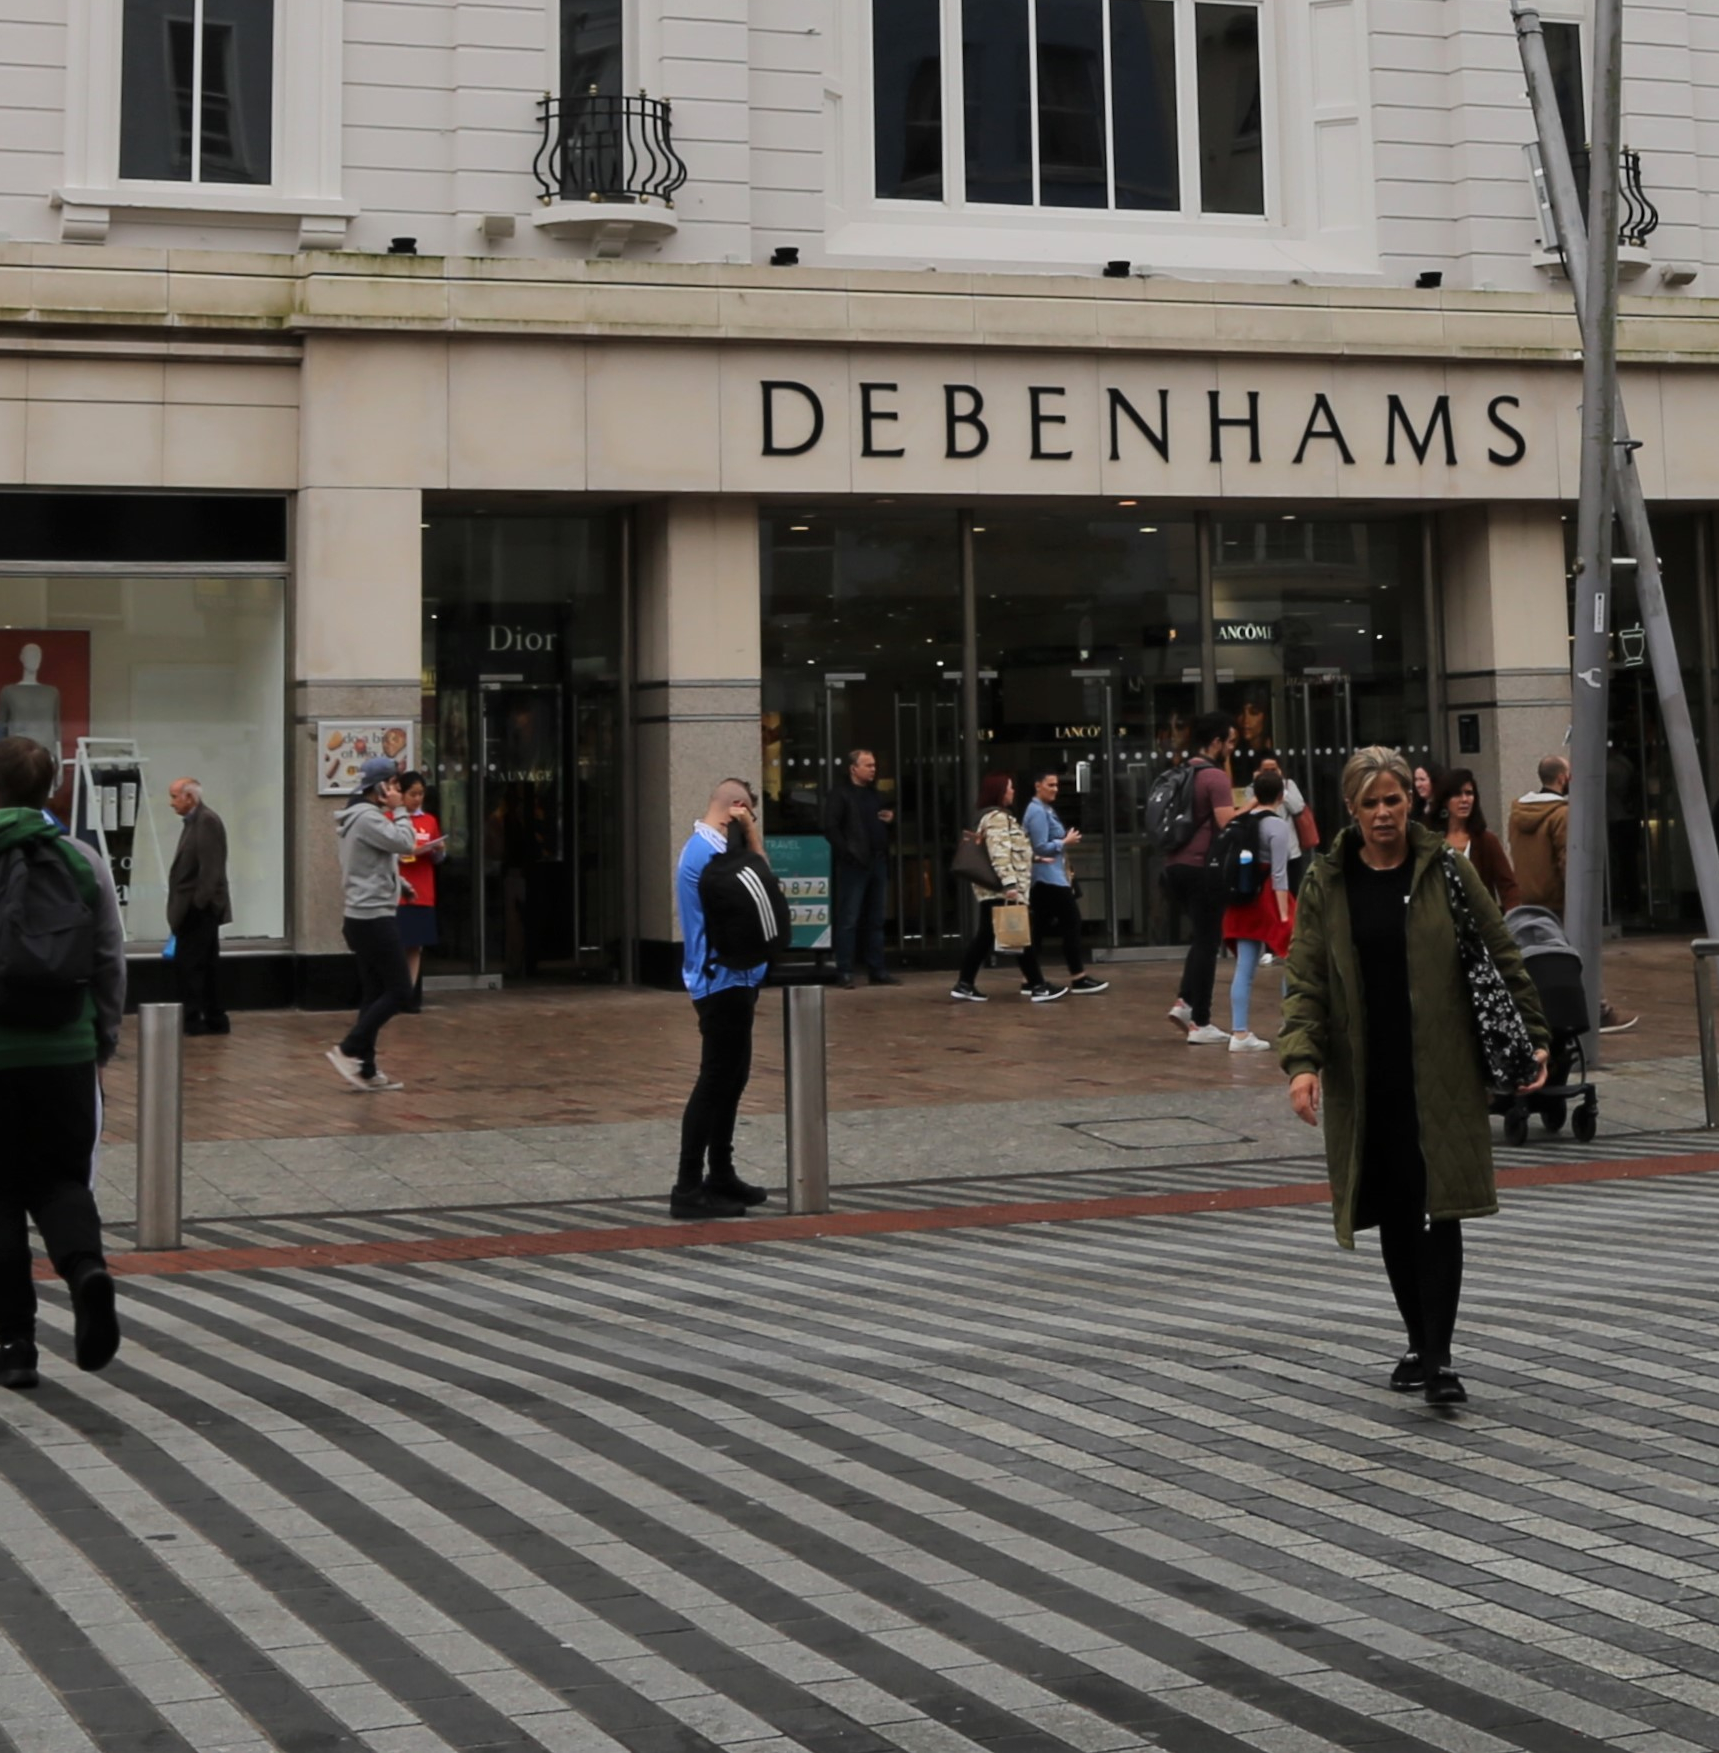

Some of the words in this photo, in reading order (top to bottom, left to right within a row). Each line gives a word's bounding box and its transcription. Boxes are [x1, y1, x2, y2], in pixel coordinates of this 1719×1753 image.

[759, 380, 1527, 466] DEBENHAMS
[488, 625, 557, 651] Dior
[1055, 724, 1101, 739] LANCÔ
